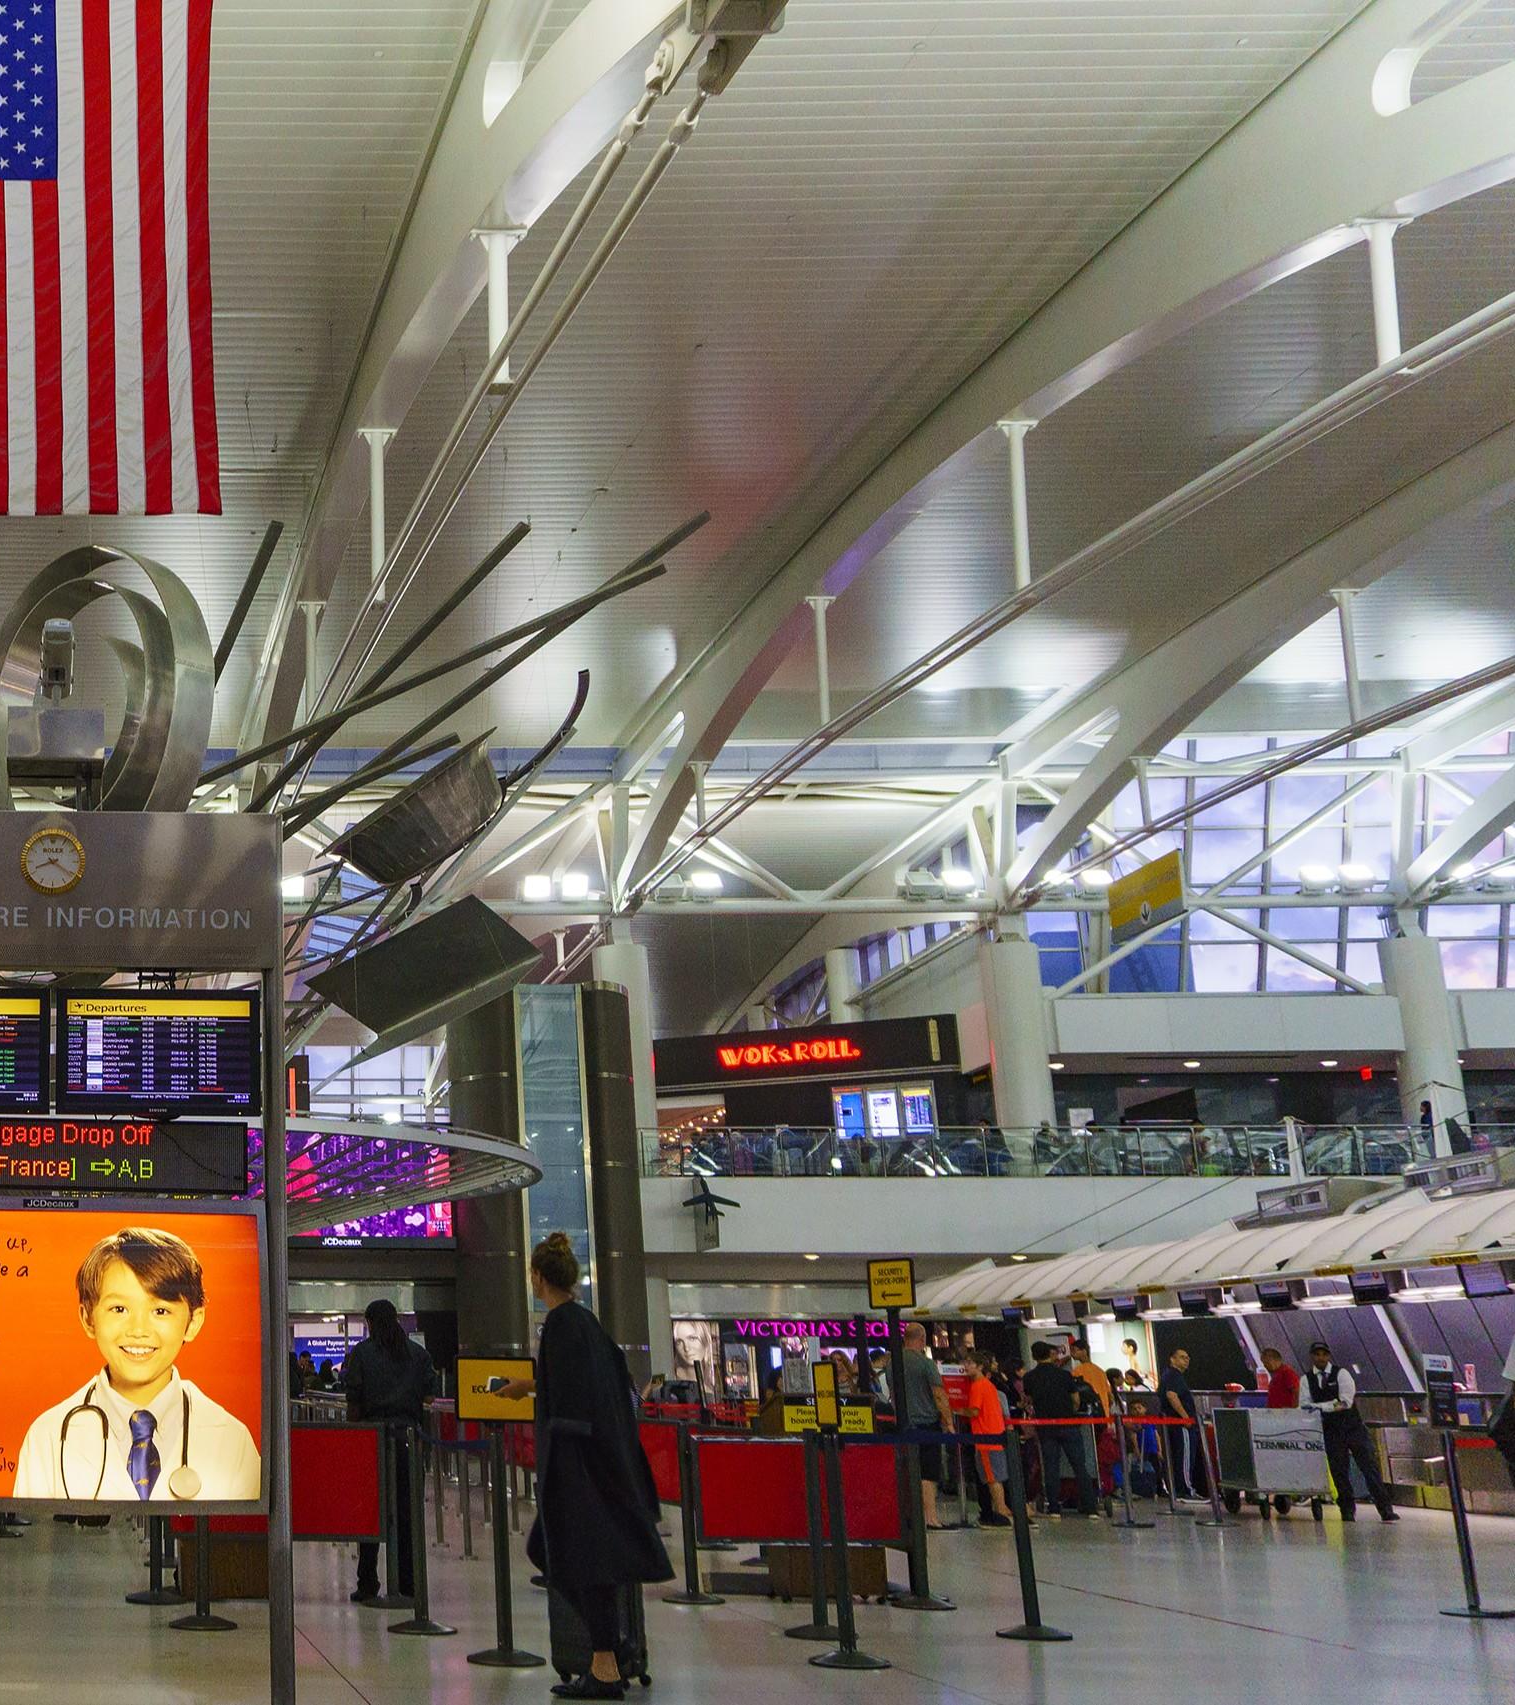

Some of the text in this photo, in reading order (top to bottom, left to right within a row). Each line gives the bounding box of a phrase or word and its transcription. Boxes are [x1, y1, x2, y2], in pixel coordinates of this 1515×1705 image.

[47, 907, 252, 929] INFORMATION
[86, 1003, 147, 1013] Departures
[62, 1123, 115, 1149] Drop
[121, 1125, 154, 1145] Off
[27, 1200, 75, 1208] JCDecaux
[322, 1237, 362, 1246] JCDecaux
[16, 1265, 29, 1277] a
[735, 1320, 842, 1337] VICTORIA'S
[842, 1409, 859, 1417] your
[845, 1418, 866, 1426] ready
[1253, 1440, 1302, 1450] TERMINAL
